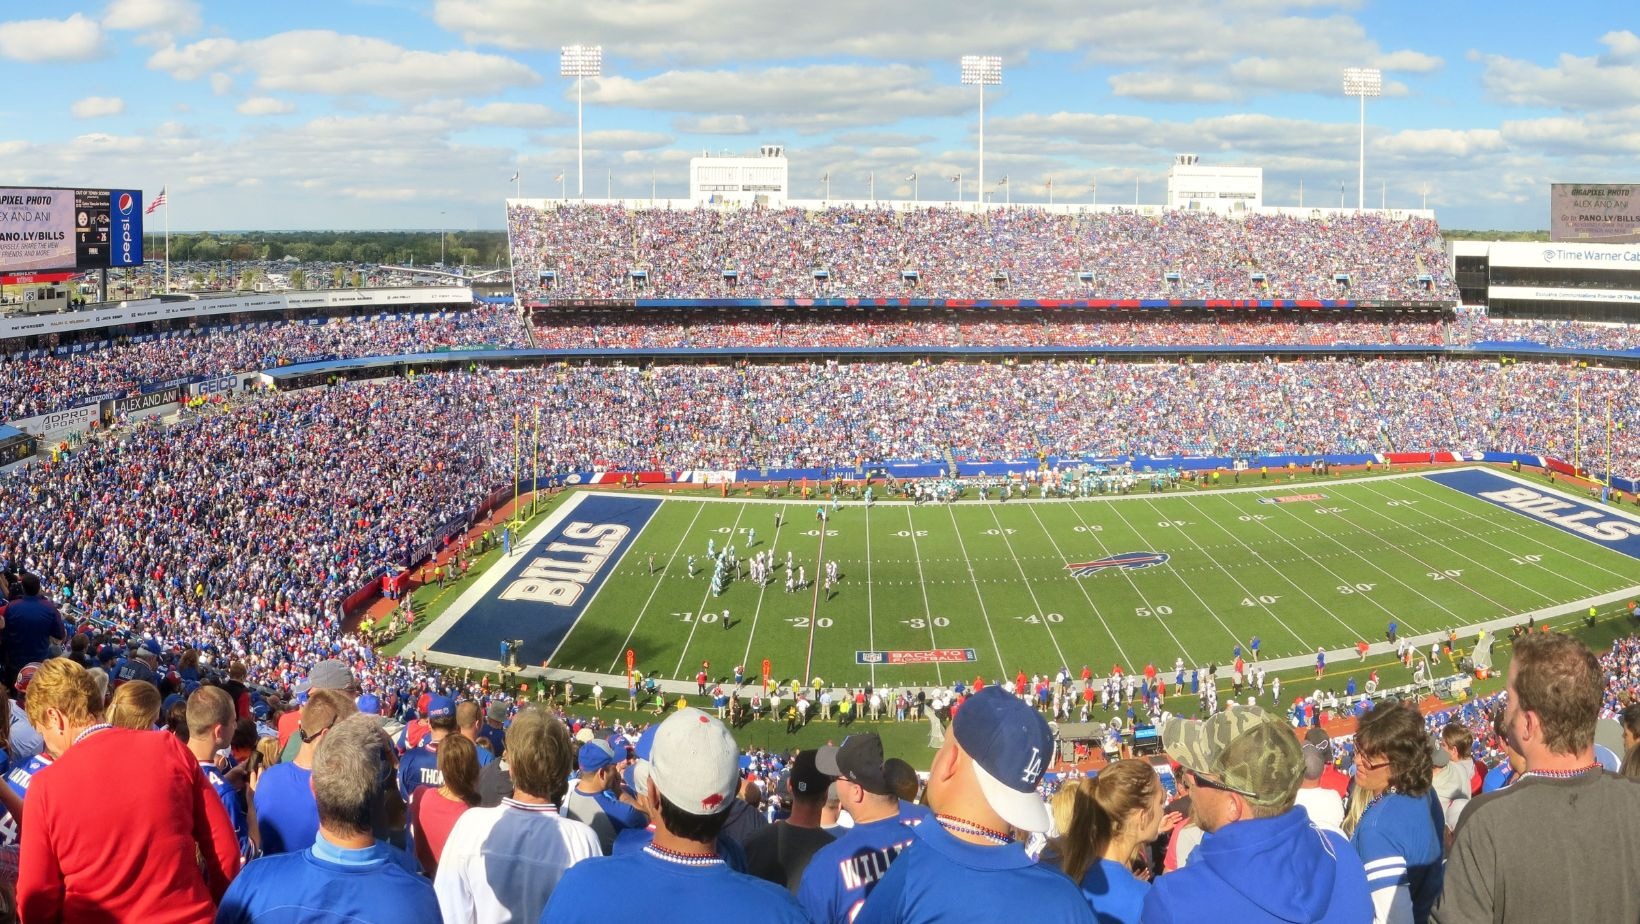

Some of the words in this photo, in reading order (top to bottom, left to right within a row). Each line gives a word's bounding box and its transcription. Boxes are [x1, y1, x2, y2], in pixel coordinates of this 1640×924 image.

[0, 196, 24, 204] PIXEL
[26, 196, 52, 205] PHOTO
[11, 212, 32, 221] AND
[35, 212, 51, 221] ANI
[121, 217, 132, 263] pepsi
[1556, 250, 1582, 260] Time
[1584, 250, 1622, 260] Warner
[198, 376, 237, 394] GEICO
[120, 400, 140, 411] ALEX
[143, 395, 160, 408] AND
[163, 391, 177, 403] ANI
[46, 417, 88, 430] SPORTS
[1477, 487, 1640, 541] BILLS
[498, 521, 631, 606] BILLS
[1135, 605, 1173, 617] 50
[892, 651, 936, 659] BACK
[1022, 746, 1042, 783] LA
